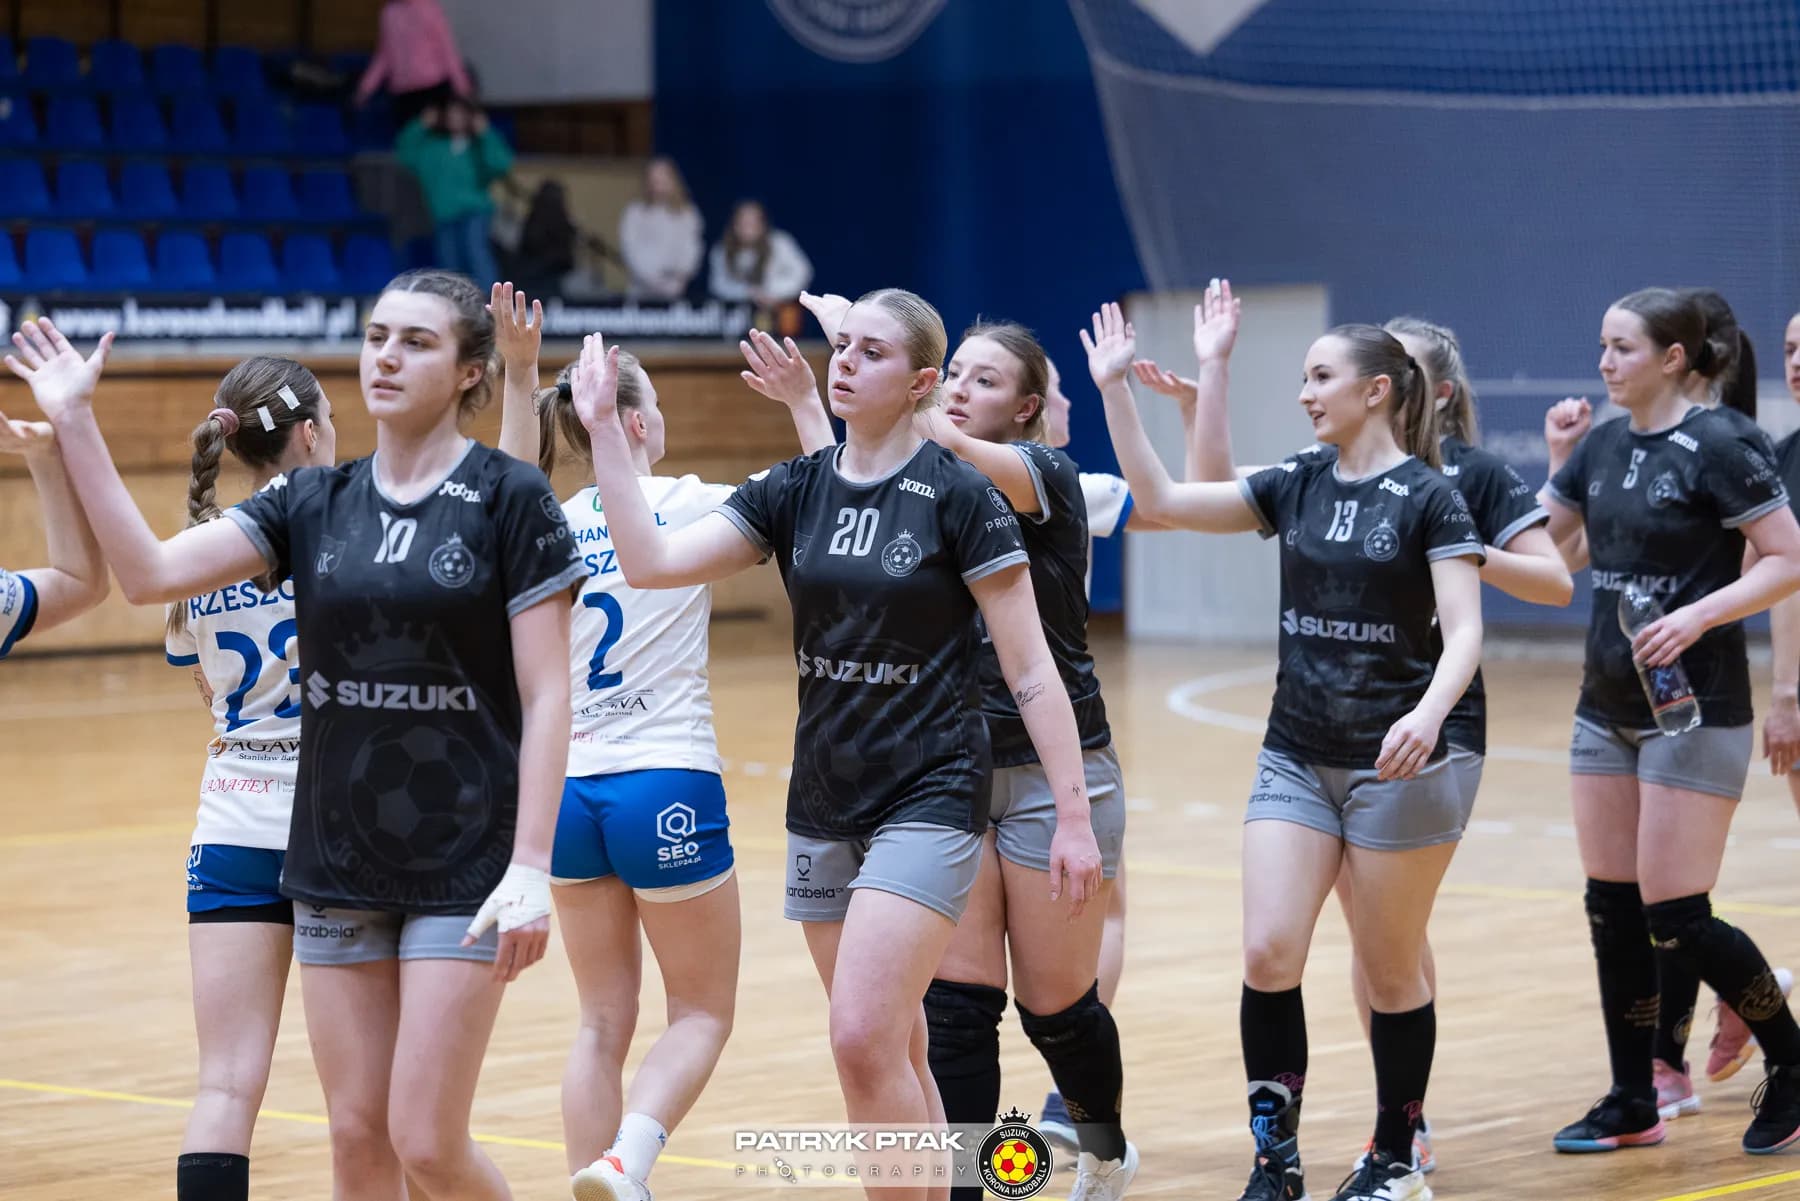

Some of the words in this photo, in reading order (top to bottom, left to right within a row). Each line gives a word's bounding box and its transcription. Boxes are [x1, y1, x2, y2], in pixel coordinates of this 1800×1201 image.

[1623, 447, 1647, 489] 5
[373, 511, 418, 564] 10
[828, 507, 881, 556] 20
[1325, 500, 1358, 542] 13
[582, 591, 624, 692] 2
[1299, 615, 1396, 643] SUZUKI
[813, 655, 920, 685] SUZUKI
[336, 682, 478, 712] SUZUKI
[657, 841, 700, 862] SEO
